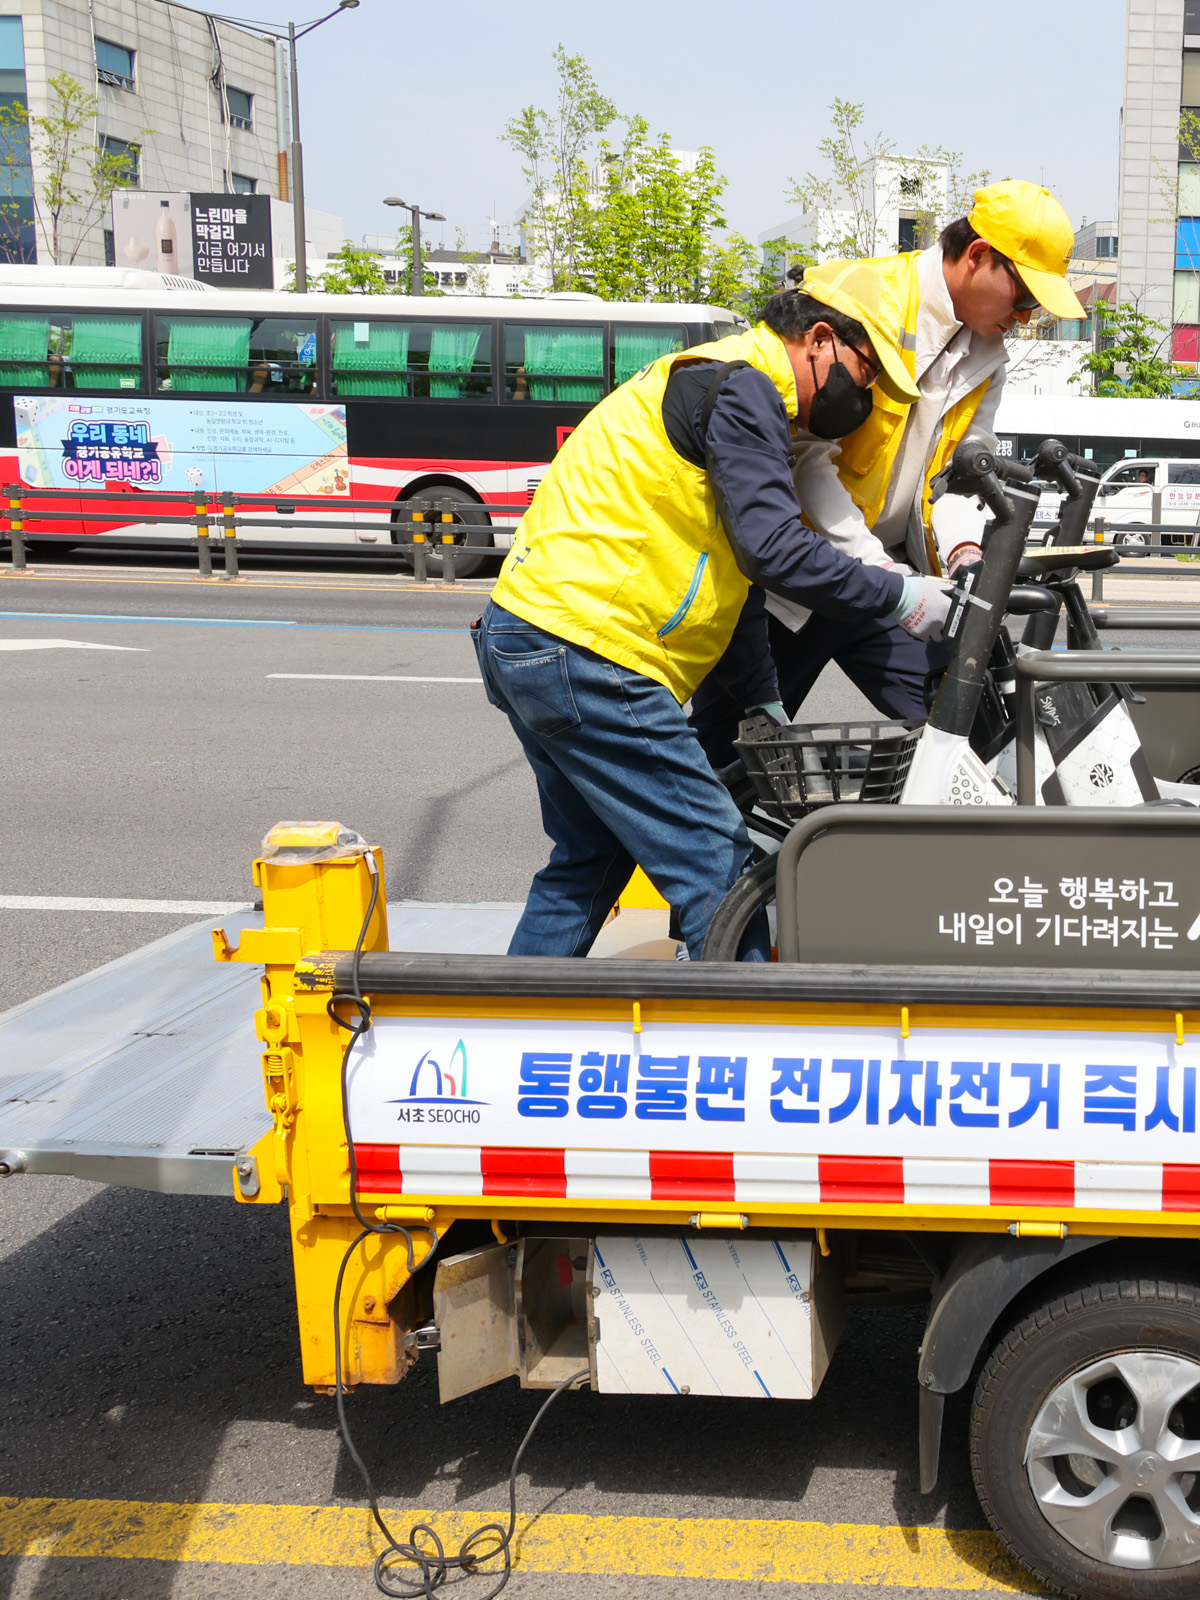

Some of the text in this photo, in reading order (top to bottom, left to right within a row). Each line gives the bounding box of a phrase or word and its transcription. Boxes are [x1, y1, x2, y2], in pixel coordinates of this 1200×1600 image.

[195, 207, 247, 225] 느린마을
[195, 224, 235, 240] 막걸리
[197, 242, 265, 258] 지금 여기서
[197, 258, 250, 274] 만듭니다
[71, 423, 147, 444] 우리 동네
[77, 446, 145, 459] 경기공유학교
[65, 460, 160, 480] 이게 되네?!
[988, 876, 1180, 910] 오늘 행복하고
[938, 912, 1179, 950] 내일이 기다려지는
[517, 1051, 749, 1123] 통행불편
[769, 1057, 1062, 1130] 전기자전거
[397, 1108, 481, 1125] 서초 SEOCHO
[610, 1287, 663, 1368] STAINLESS STEEL
[702, 1290, 756, 1370] STAINLESS STEEL
